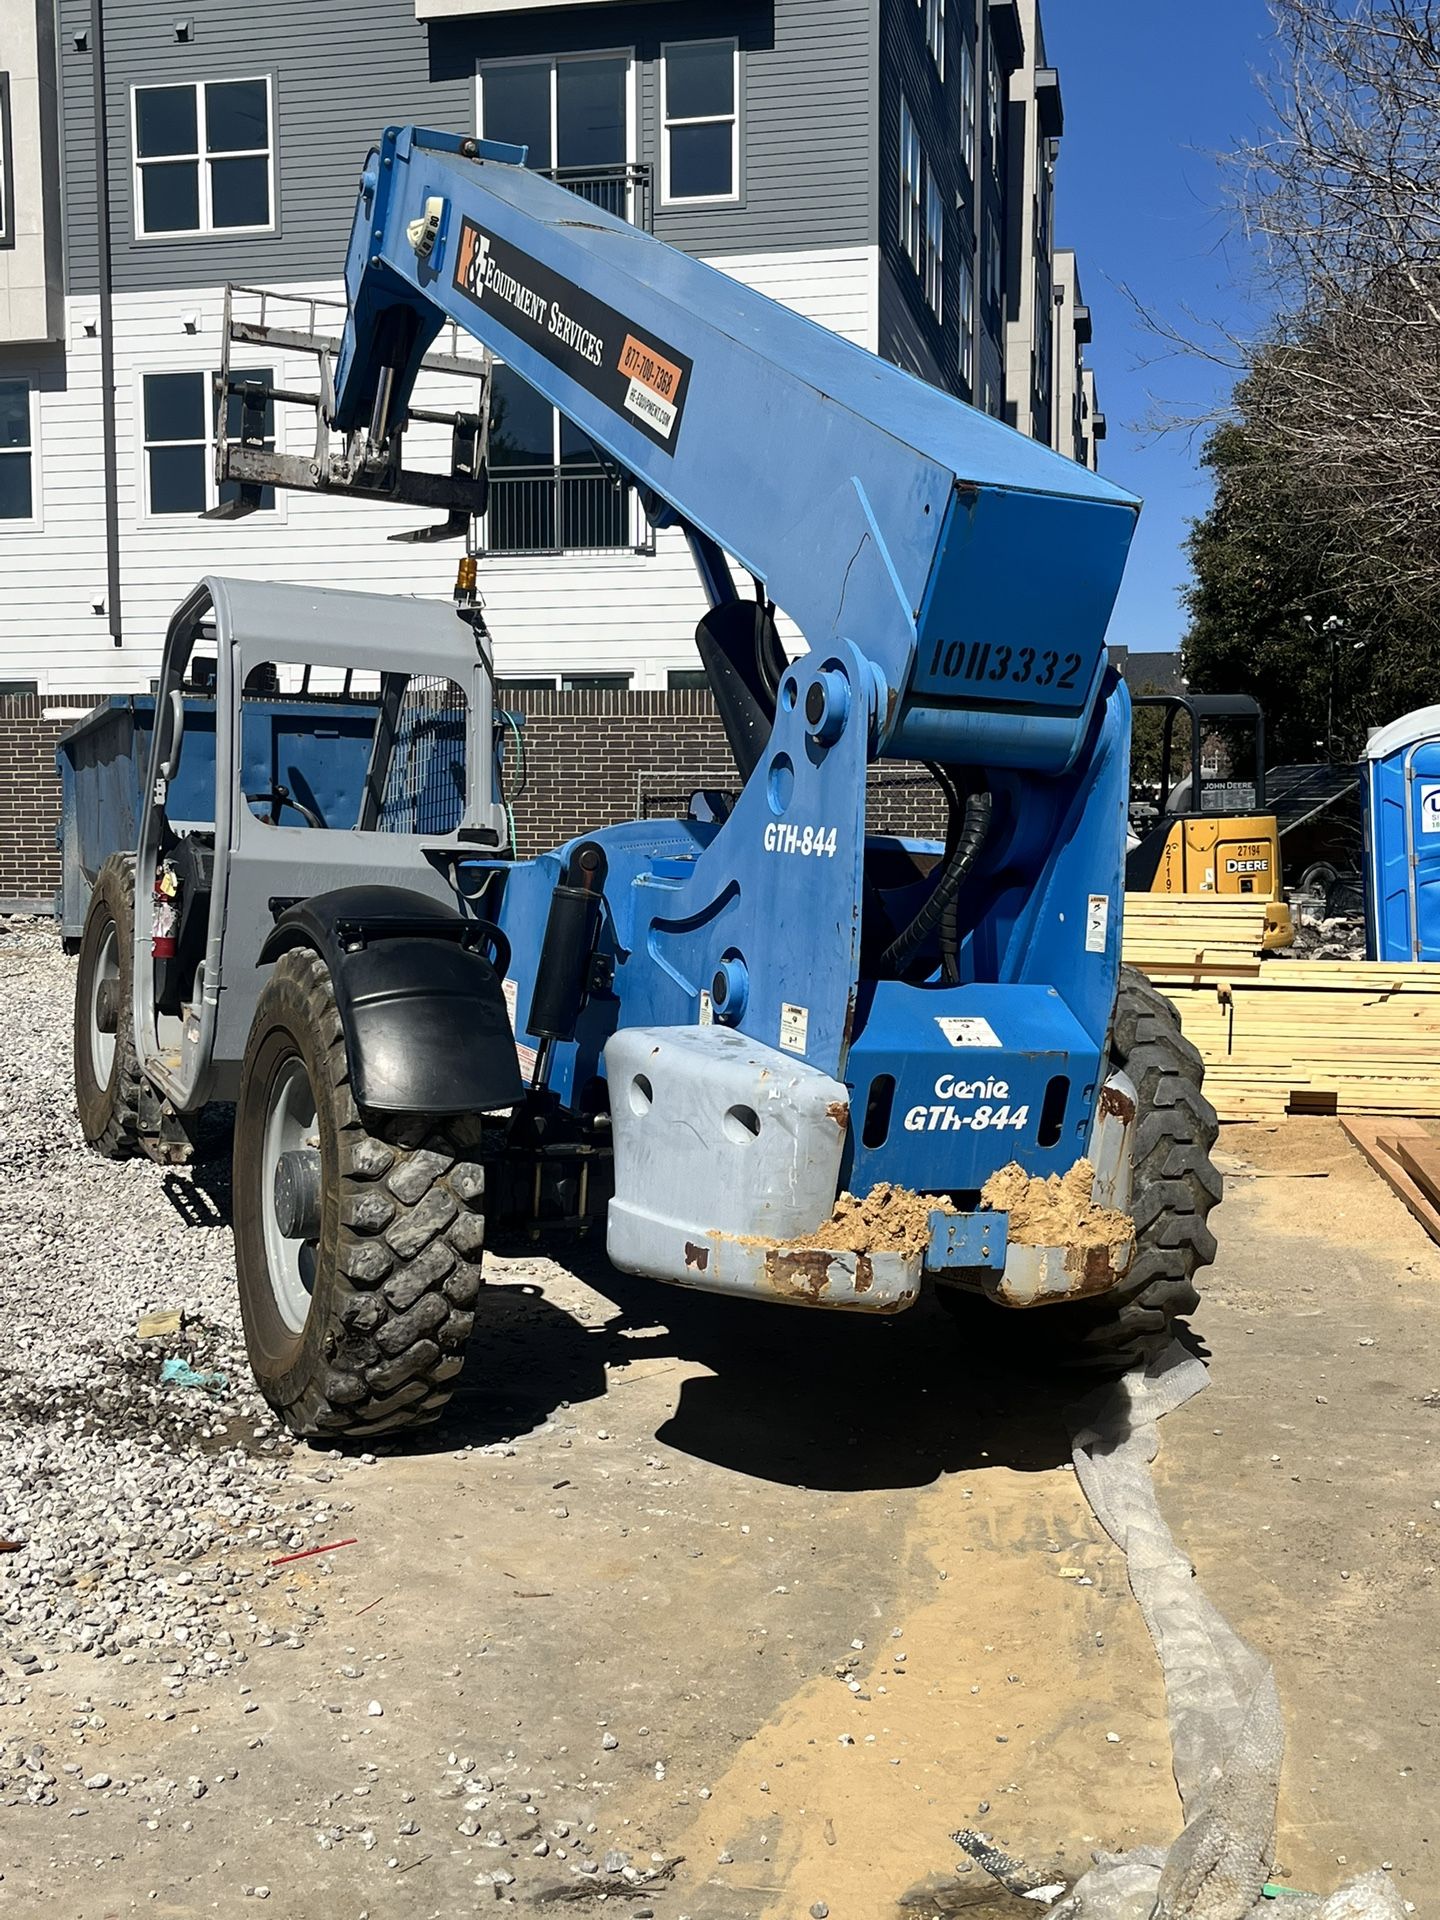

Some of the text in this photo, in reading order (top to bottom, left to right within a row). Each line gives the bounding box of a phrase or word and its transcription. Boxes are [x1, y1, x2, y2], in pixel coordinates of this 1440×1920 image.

[624, 346, 673, 395] 877-700-7368
[929, 639, 1082, 689] 10113332
[1204, 781, 1253, 790] JOHN DEERE
[764, 822, 837, 858] GTH-844
[1237, 846, 1261, 857] 27194
[1226, 859, 1269, 873] DEERE
[934, 1074, 1010, 1099] Genie
